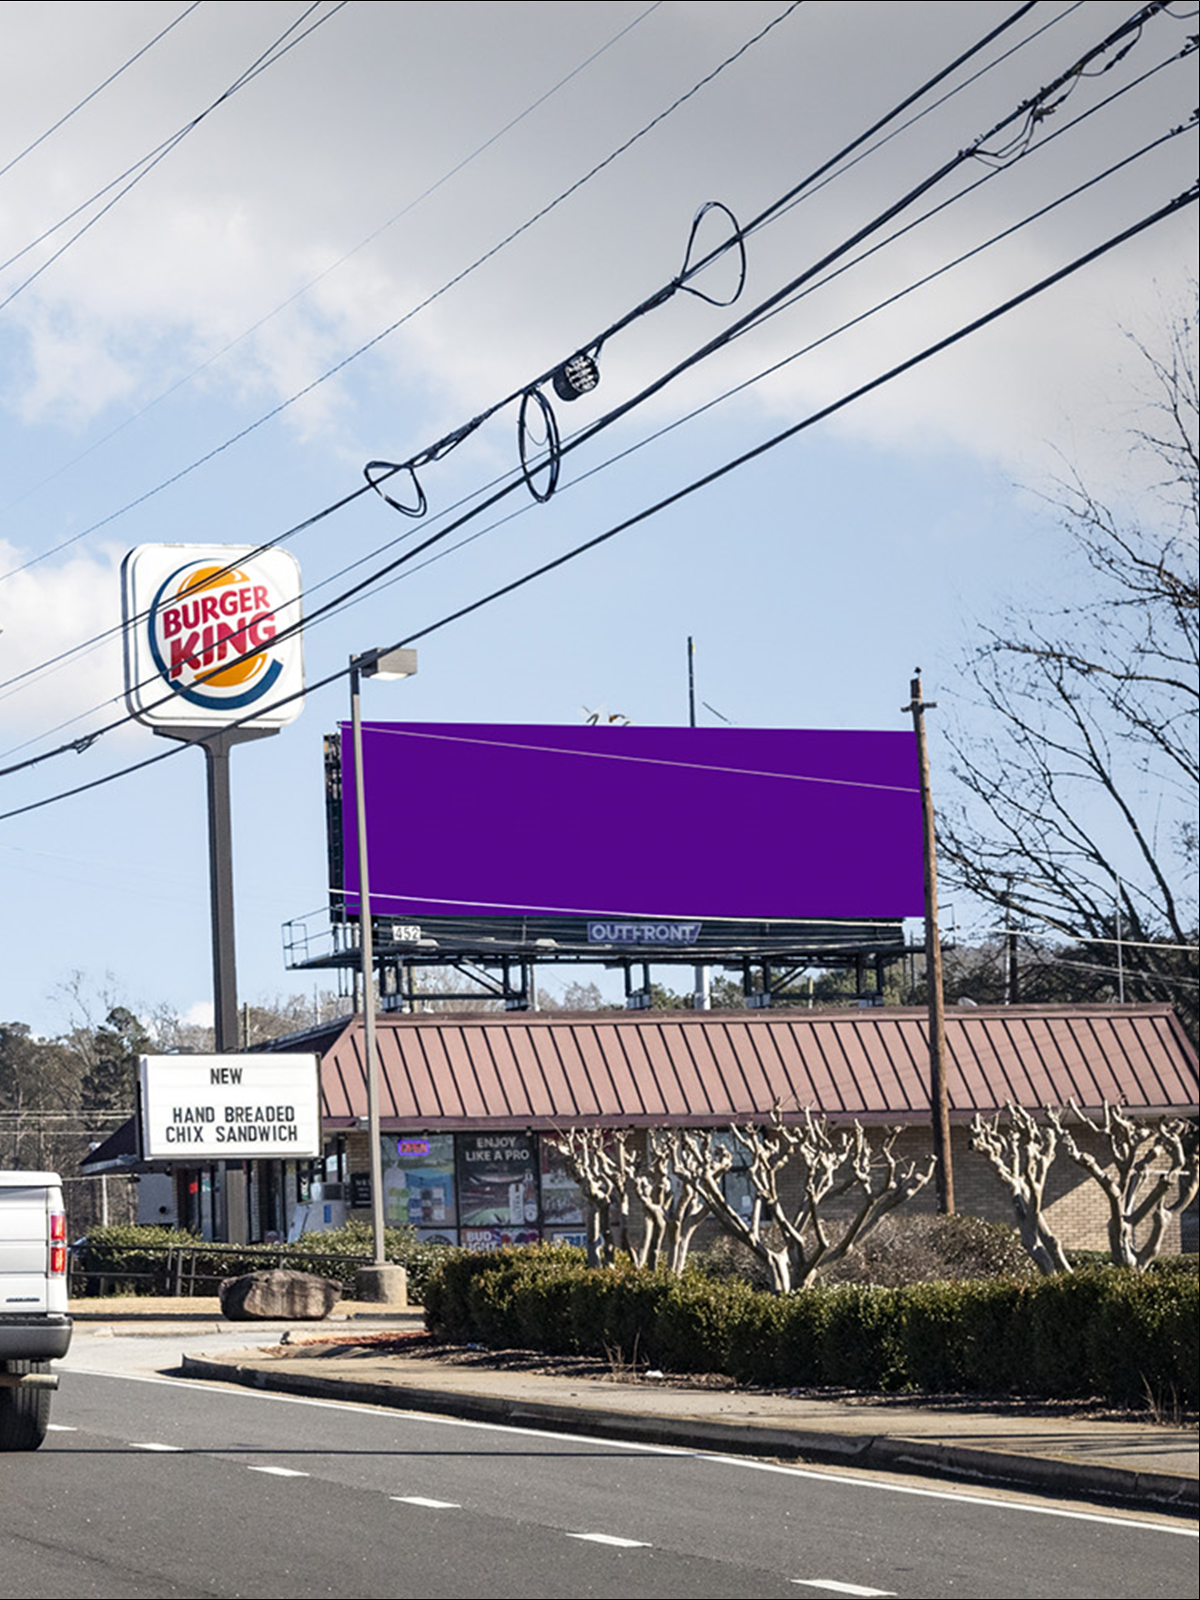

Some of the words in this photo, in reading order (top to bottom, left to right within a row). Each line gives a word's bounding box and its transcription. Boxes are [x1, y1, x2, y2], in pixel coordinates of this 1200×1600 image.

[163, 585, 270, 640] BURGER
[169, 611, 276, 679] KING
[395, 926, 419, 940] 452
[592, 924, 695, 941] OUTFRONT
[210, 1068, 242, 1084] NEW
[173, 1106, 215, 1123] HAND
[224, 1106, 295, 1122] BREADED
[165, 1126, 204, 1143] CHIX
[216, 1125, 298, 1142] SANDWICH
[401, 1142, 428, 1153] OPEN
[476, 1137, 517, 1148] ENJOY
[465, 1150, 492, 1162] LIKE
[494, 1150, 503, 1161] A
[505, 1149, 530, 1161] PRO
[467, 1231, 492, 1241] BUD
[462, 1242, 498, 1252] LIGHT
